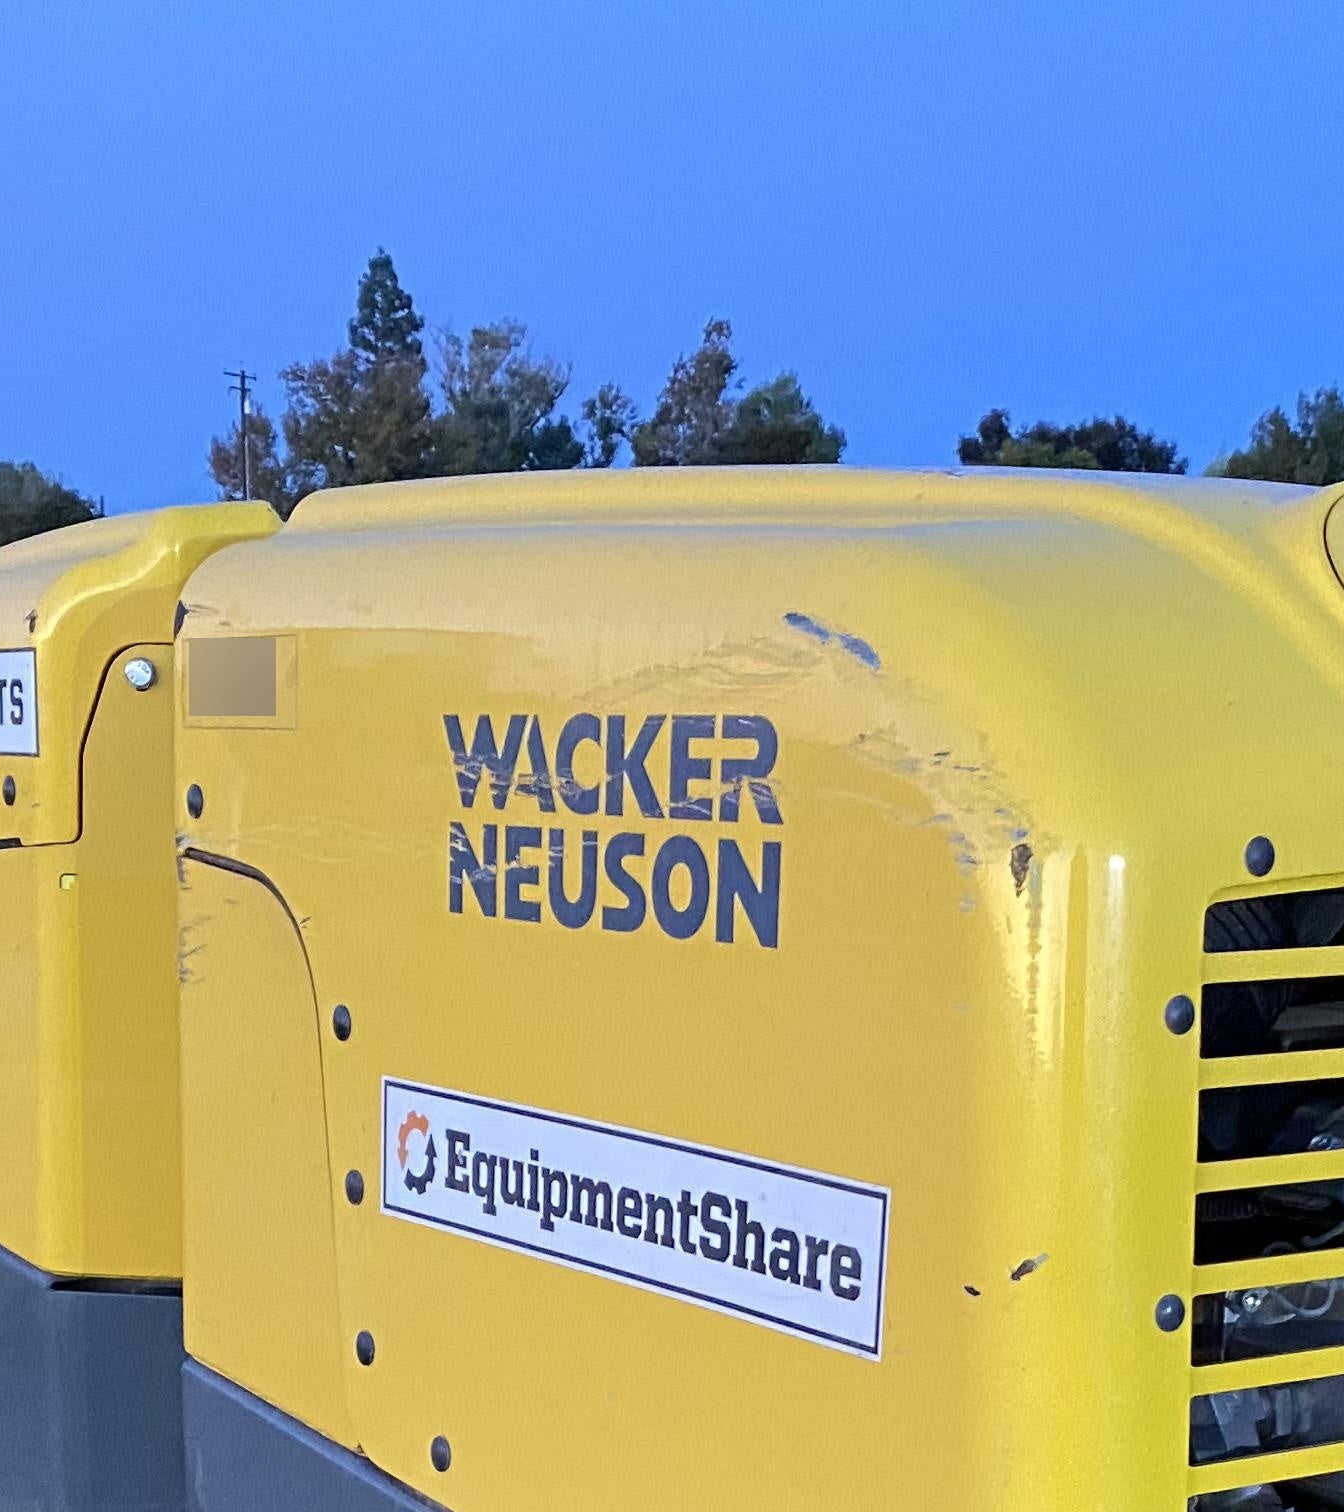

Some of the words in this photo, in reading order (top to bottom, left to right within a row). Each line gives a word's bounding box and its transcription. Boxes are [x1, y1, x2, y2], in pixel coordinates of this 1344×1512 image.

[442, 712, 784, 825] WACKER
[449, 820, 782, 950] NEUSON
[444, 1128, 862, 1301] EquipmentShare
